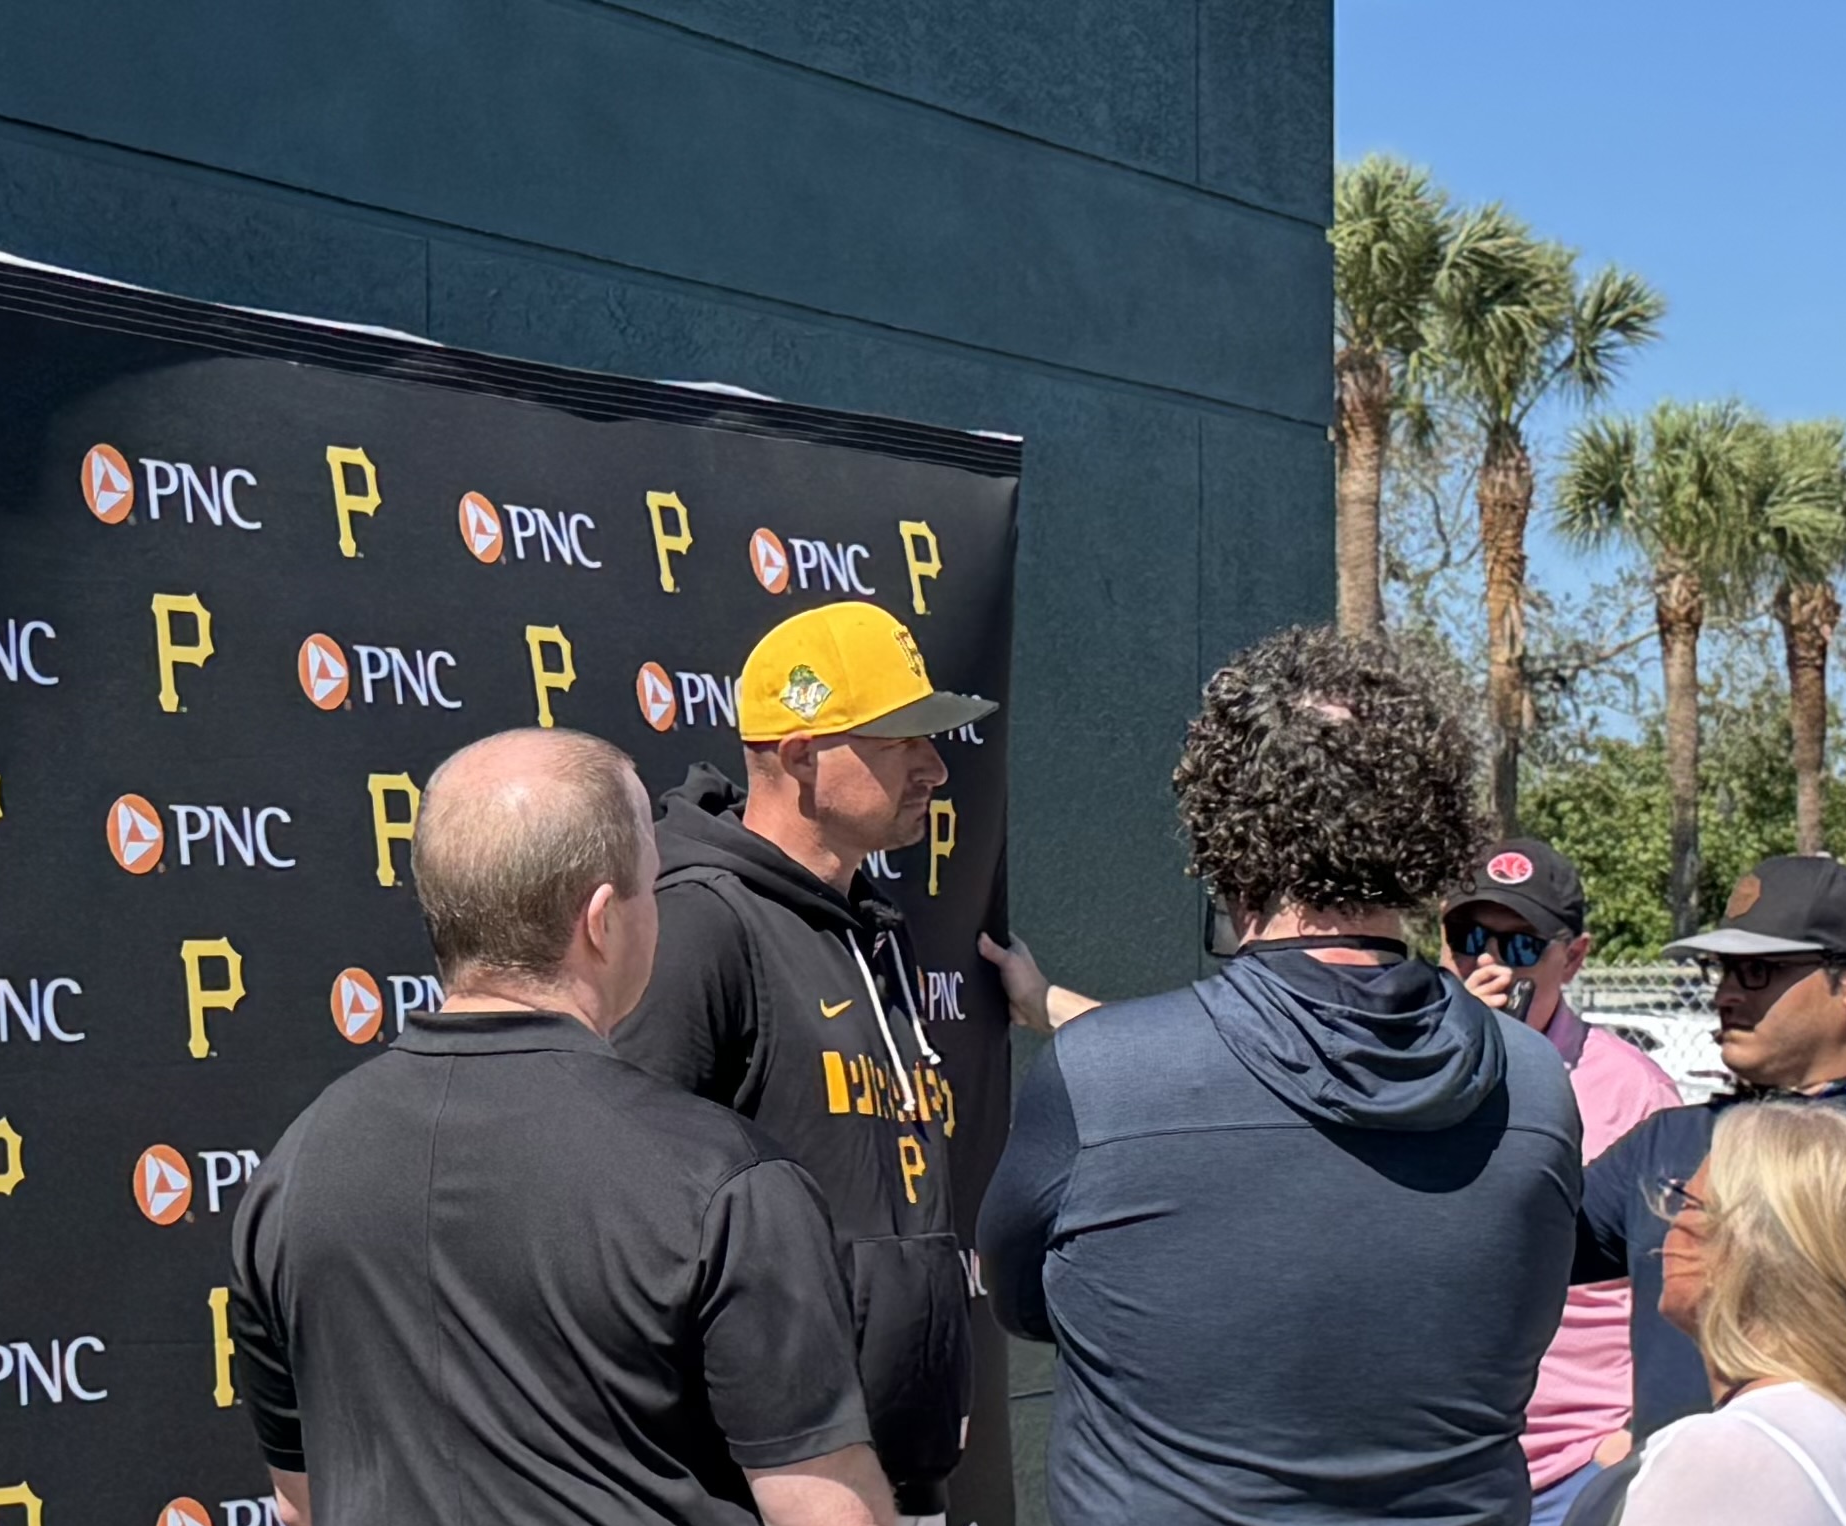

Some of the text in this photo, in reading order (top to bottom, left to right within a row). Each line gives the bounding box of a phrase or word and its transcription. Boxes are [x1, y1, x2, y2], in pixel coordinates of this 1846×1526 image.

[138, 457, 263, 530] PNC
[326, 446, 382, 558] P
[503, 503, 602, 569] PNC
[646, 491, 693, 593] P
[788, 537, 876, 596] PNC
[899, 520, 942, 615] P
[151, 593, 215, 713] P
[352, 644, 463, 709] PNC
[525, 624, 577, 730] P
[675, 671, 737, 728] PN
[169, 804, 297, 868] PNC
[368, 772, 421, 887] P
[929, 798, 957, 896] P
[180, 938, 247, 1059] P
[927, 970, 966, 1021] PNC
[898, 1135, 927, 1204] P
